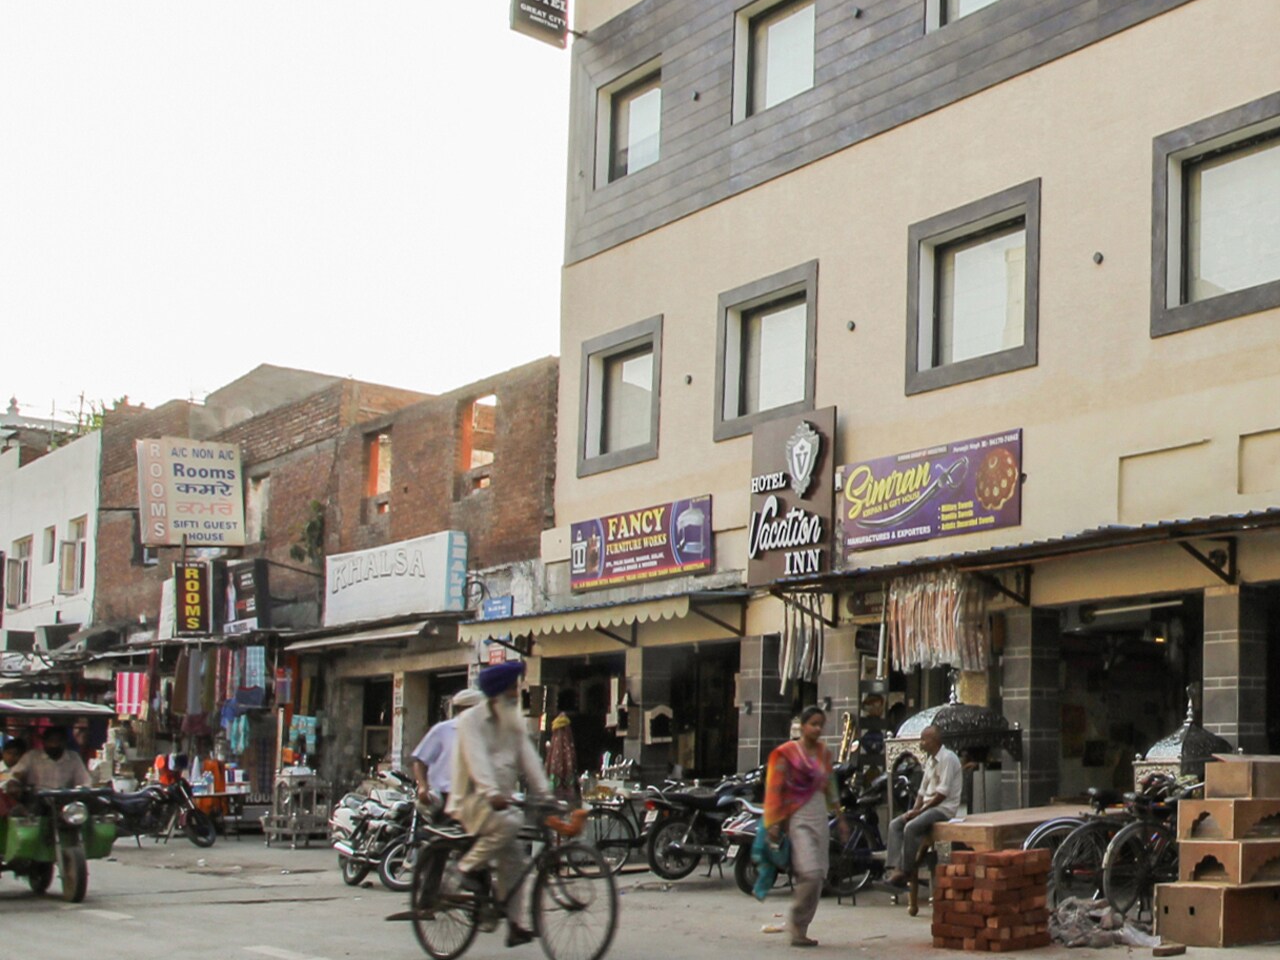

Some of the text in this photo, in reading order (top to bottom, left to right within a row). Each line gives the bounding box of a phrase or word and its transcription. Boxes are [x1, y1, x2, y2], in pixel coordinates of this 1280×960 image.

[171, 447, 235, 460] A/C NON A/C
[173, 463, 236, 480] Rooms
[751, 472, 786, 493] HOTEL
[150, 442, 167, 537] ROOMS
[175, 481, 234, 497] कमरे
[845, 461, 932, 520] Simran
[203, 520, 238, 530] GUEST
[607, 507, 665, 541] FANCY
[749, 494, 822, 560] Vacation
[897, 526, 931, 539] EXPORTERS
[188, 532, 225, 541] HOUSE
[606, 533, 667, 556] FURNITURE WORKS
[331, 548, 426, 595] KHALSA
[784, 548, 821, 575] INN
[185, 568, 201, 629] ROOMS
